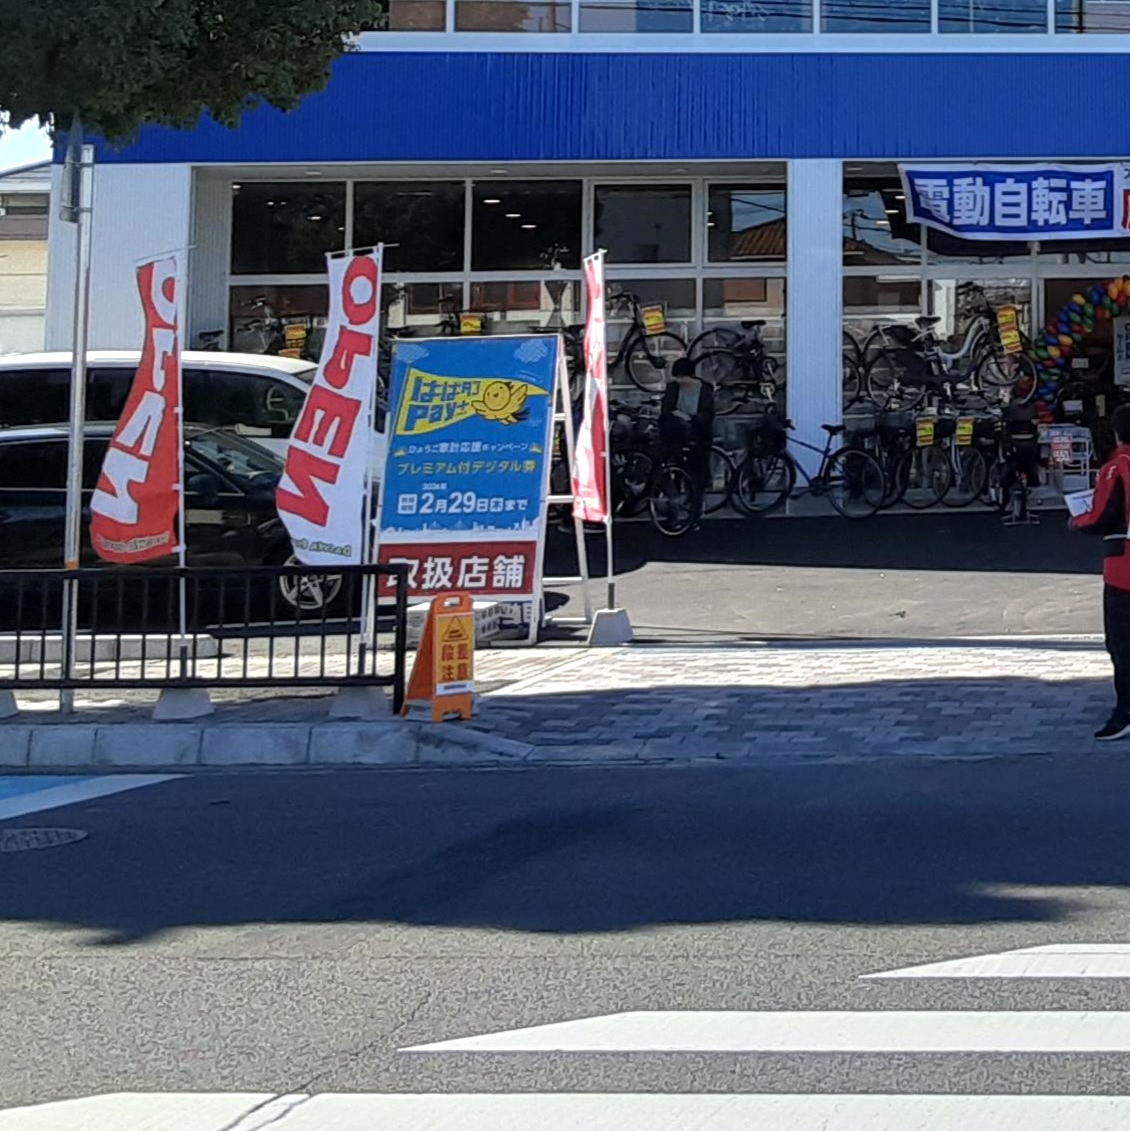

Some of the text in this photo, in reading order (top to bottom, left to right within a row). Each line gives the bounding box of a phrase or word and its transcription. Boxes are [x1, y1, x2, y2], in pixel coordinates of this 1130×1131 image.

[912, 176, 1107, 227] 電動自転車
